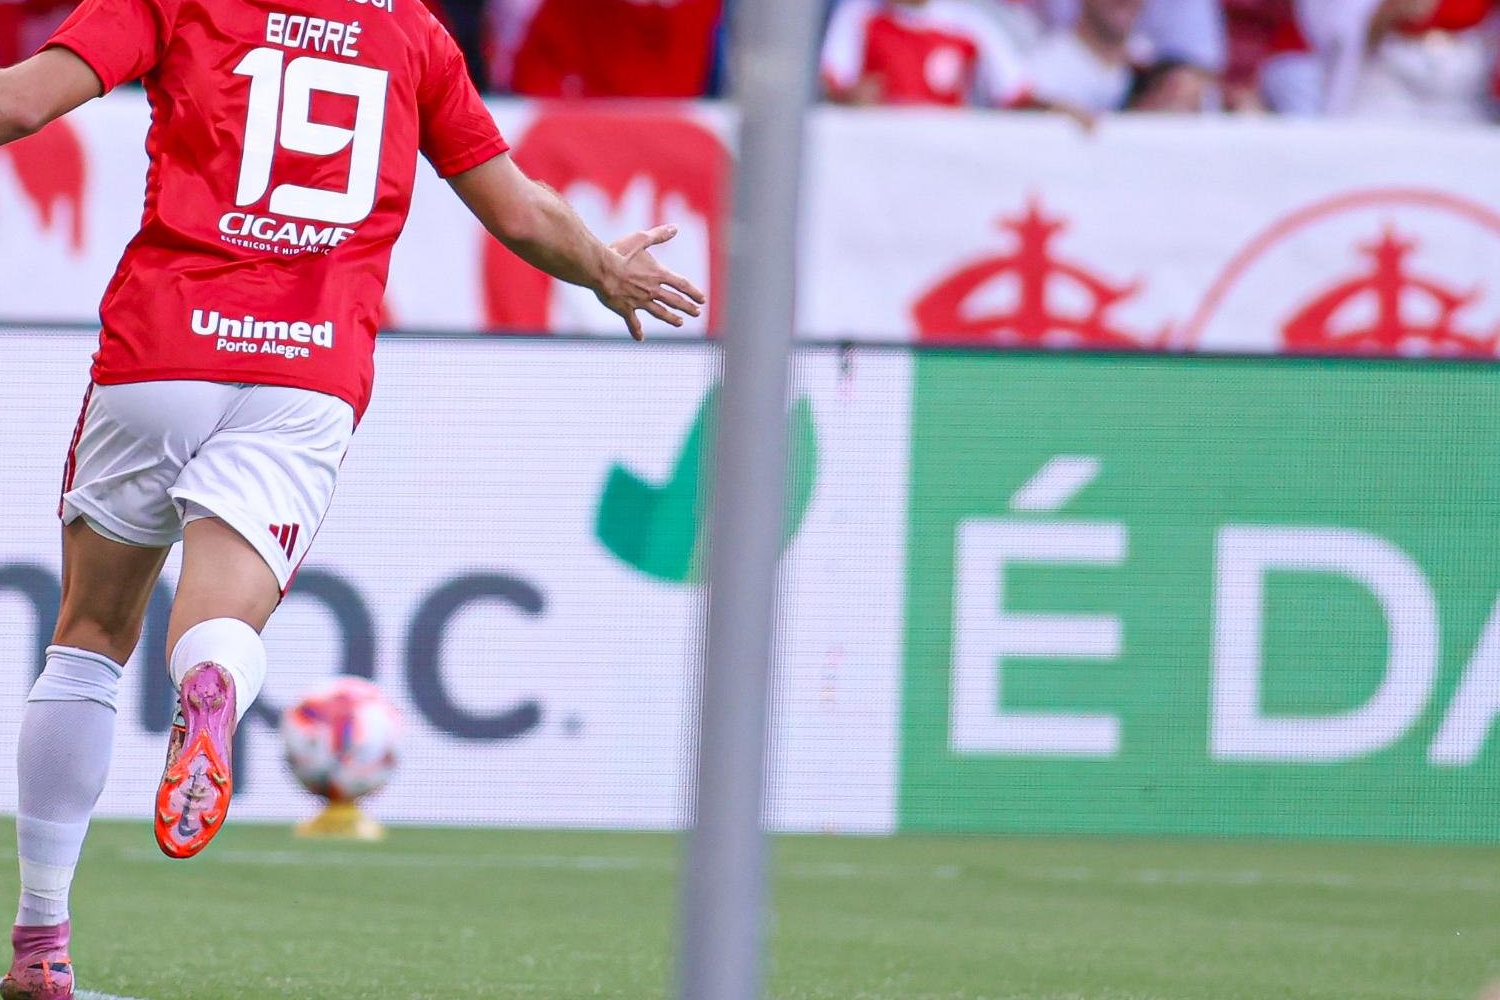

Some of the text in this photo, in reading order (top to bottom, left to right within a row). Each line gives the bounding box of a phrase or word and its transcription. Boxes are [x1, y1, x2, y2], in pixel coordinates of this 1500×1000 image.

[266, 12, 362, 58] BORRÉ
[232, 47, 389, 224] 19
[191, 309, 333, 348] Unimed
[216, 338, 310, 359] Porto Alegre
[948, 455, 1128, 757] É
